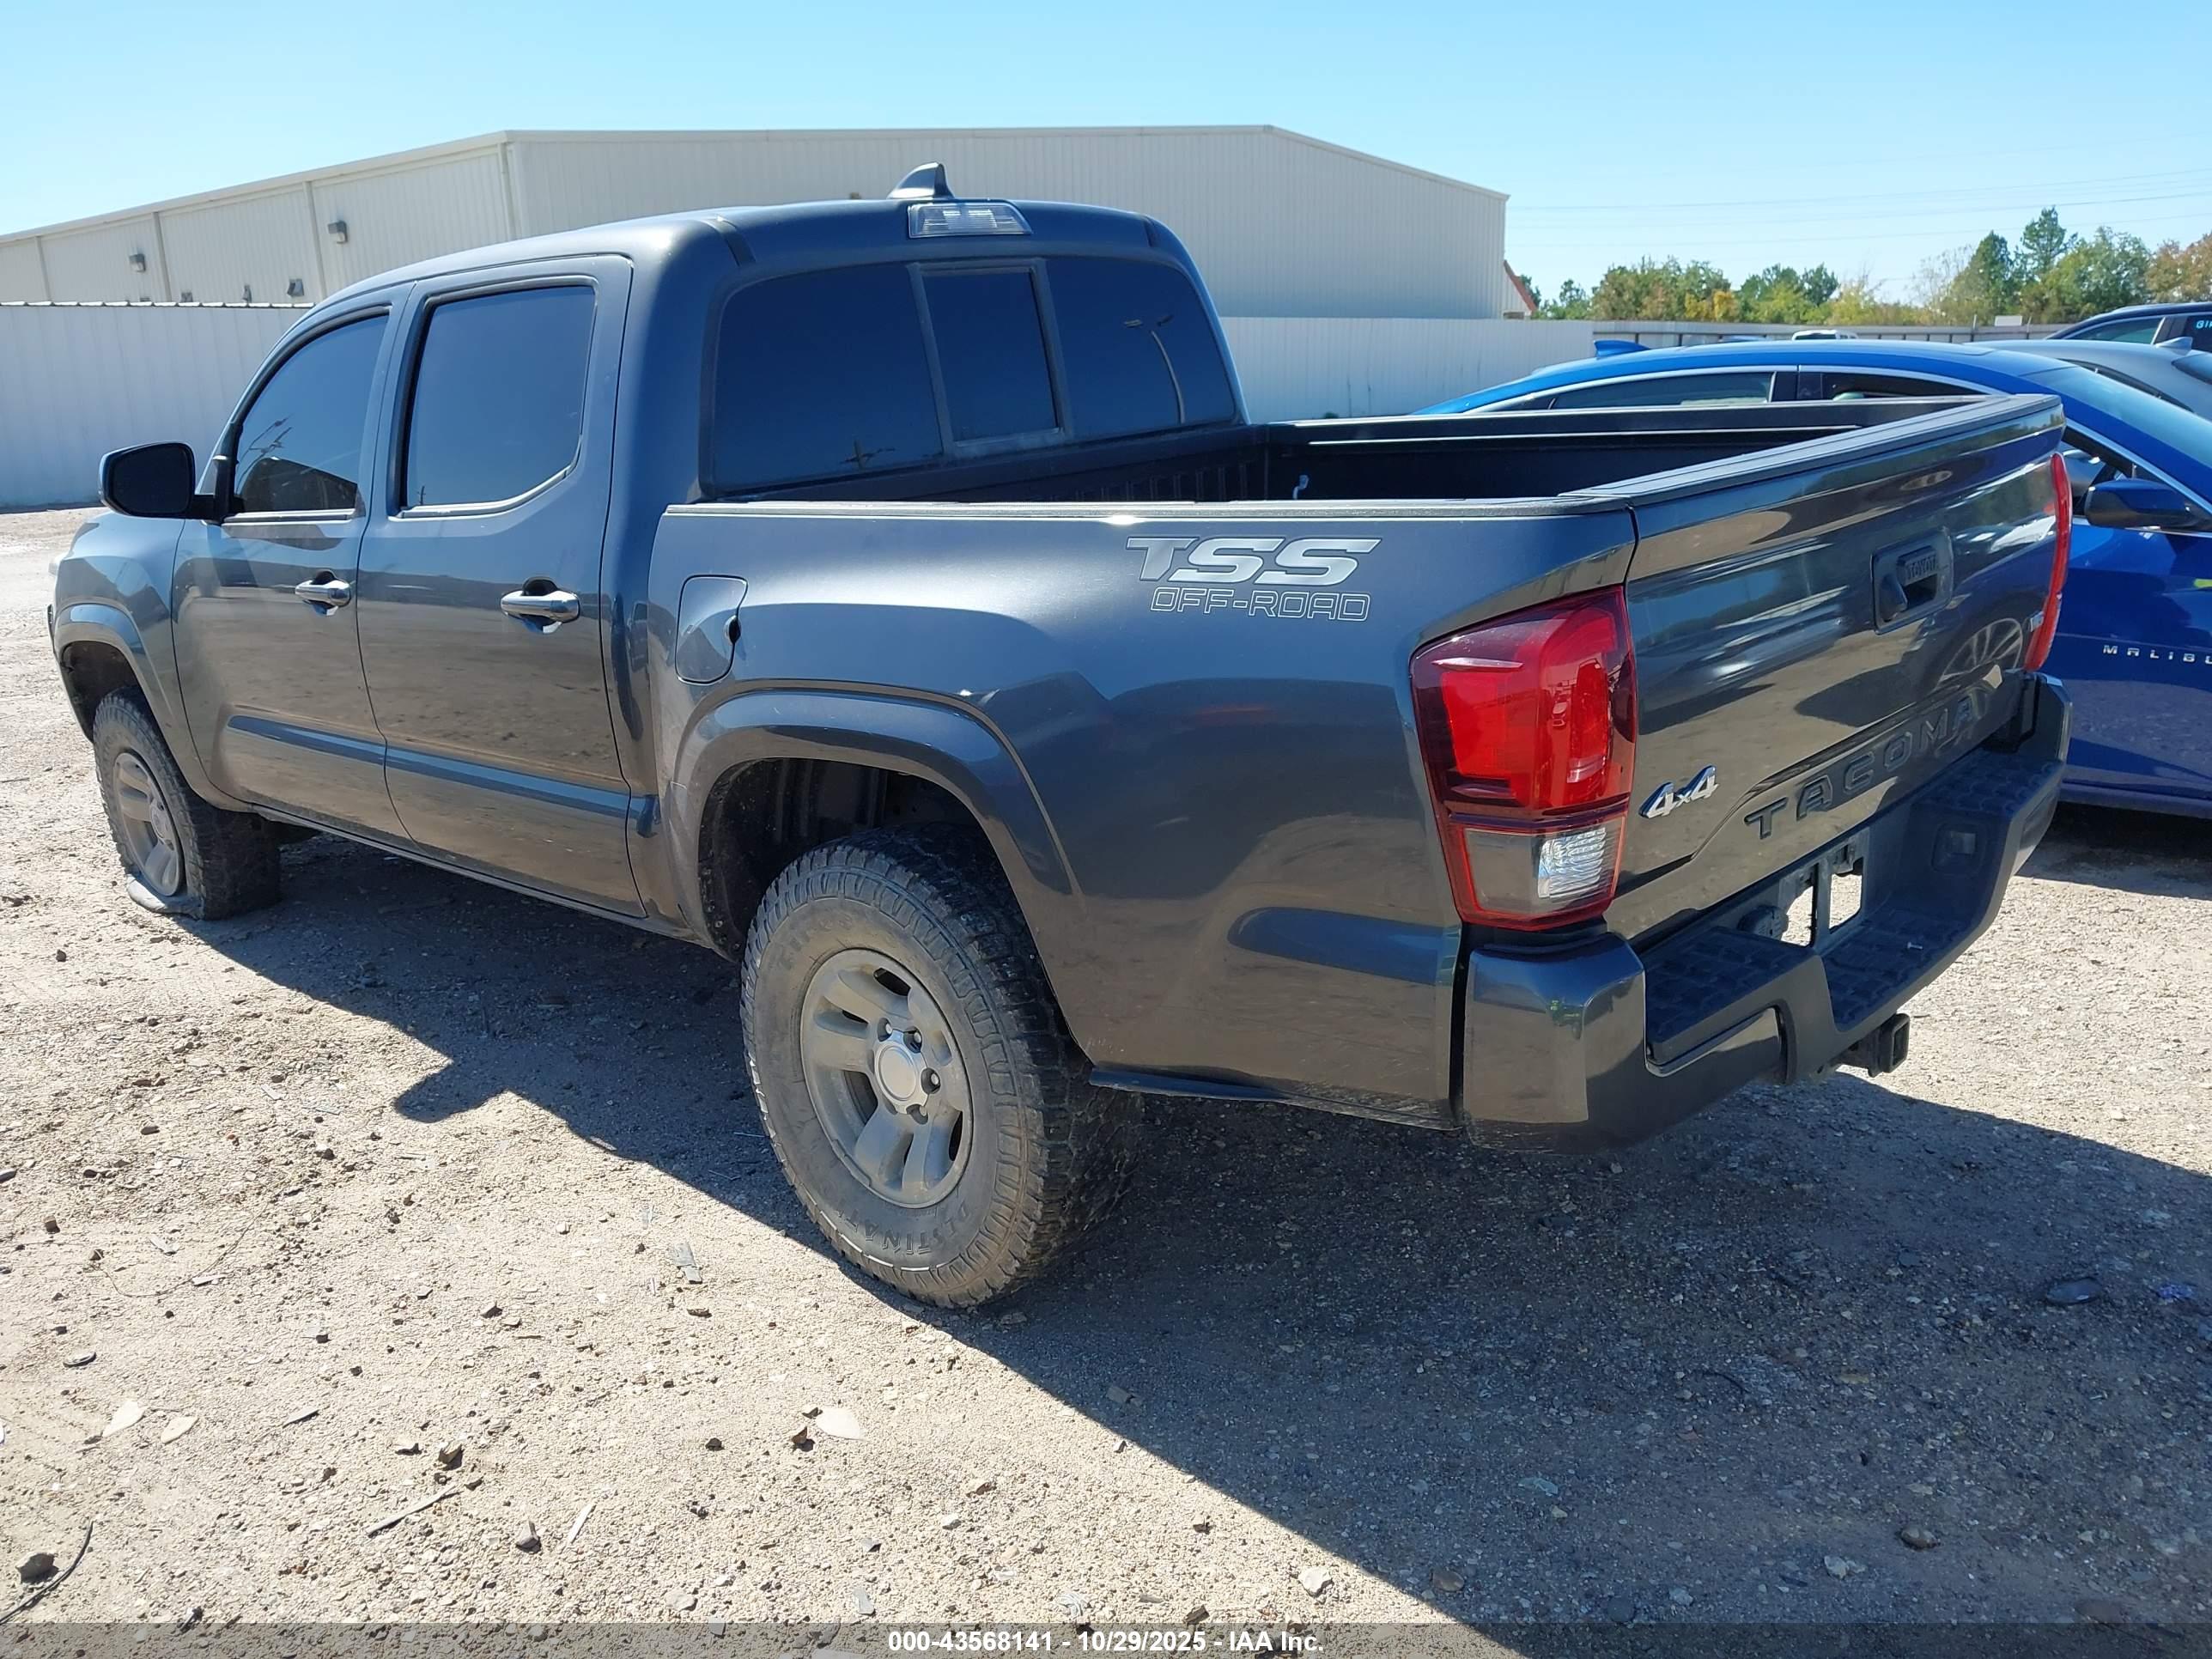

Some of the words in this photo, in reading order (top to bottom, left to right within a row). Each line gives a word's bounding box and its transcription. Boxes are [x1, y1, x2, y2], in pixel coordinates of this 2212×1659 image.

[1126, 537, 1382, 586] TSS
[1908, 556, 1938, 580] TOYOT
[1151, 586, 1371, 622] OFF-ROAD
